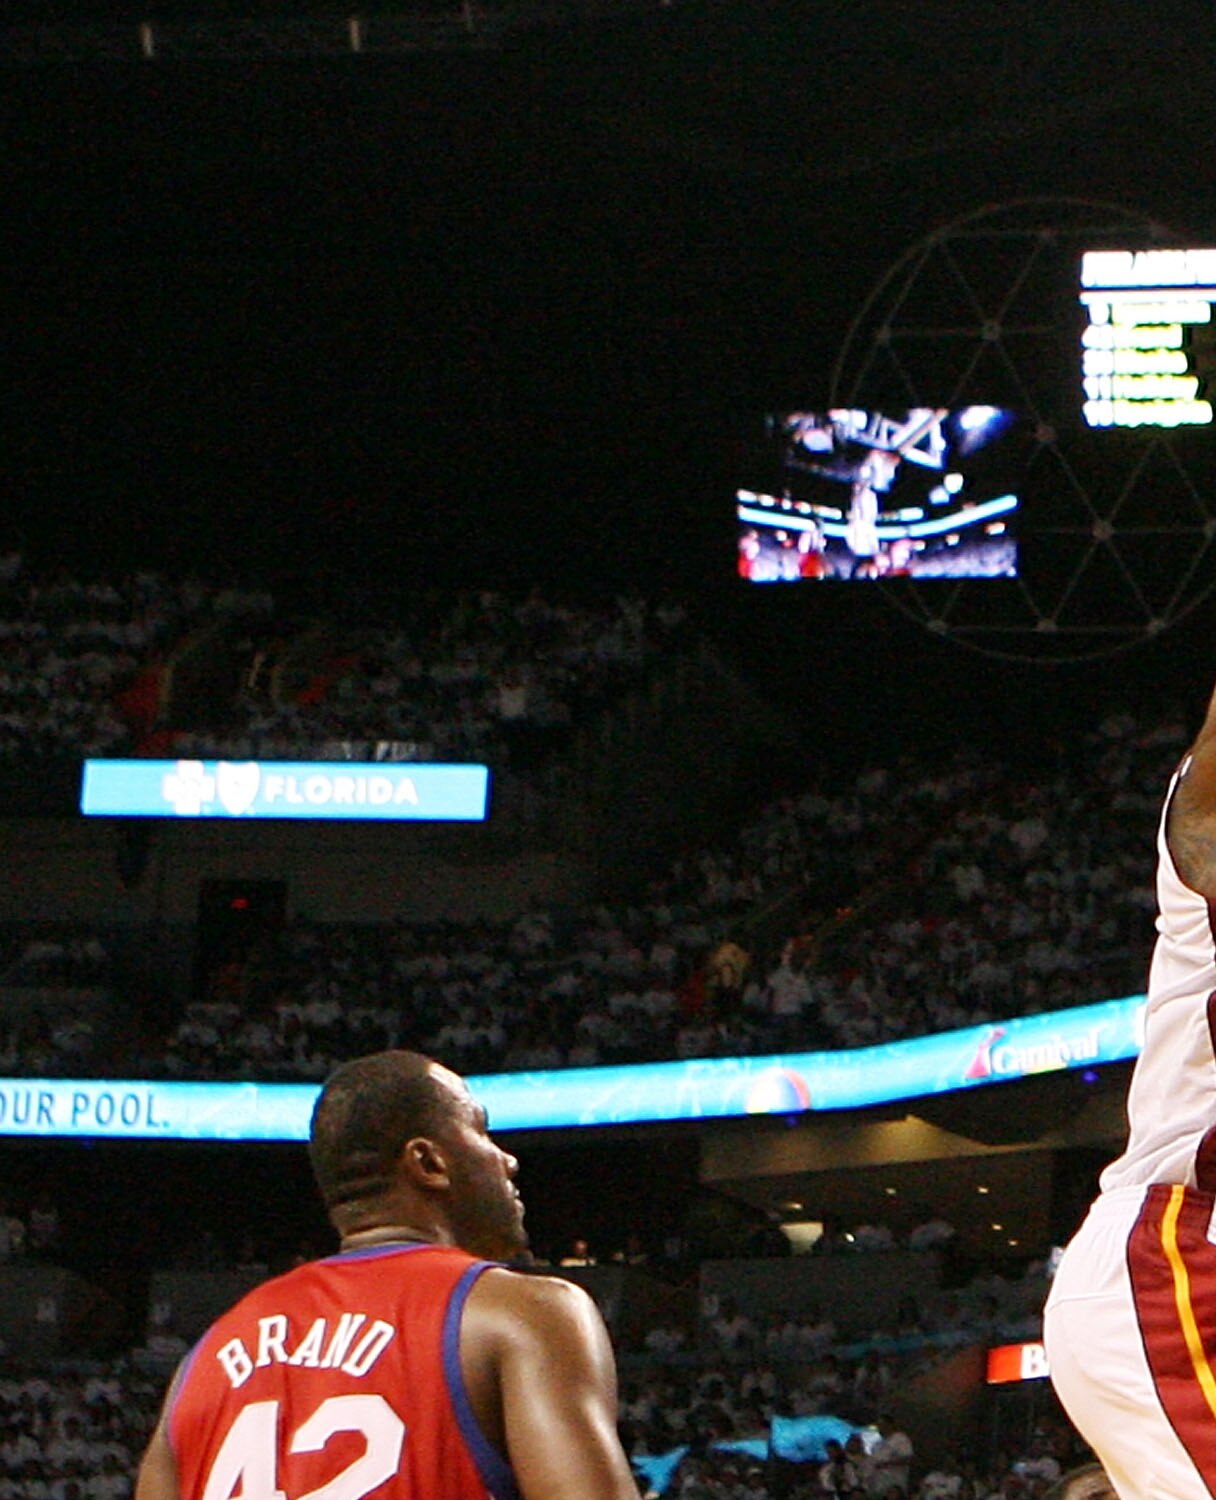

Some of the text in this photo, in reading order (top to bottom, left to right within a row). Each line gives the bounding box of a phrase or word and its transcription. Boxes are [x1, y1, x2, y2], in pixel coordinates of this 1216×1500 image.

[264, 776, 418, 805] FLORIDA
[992, 1031, 1099, 1074] Carnival
[70, 1091, 171, 1130] POOL.
[215, 1312, 396, 1389] BRAND
